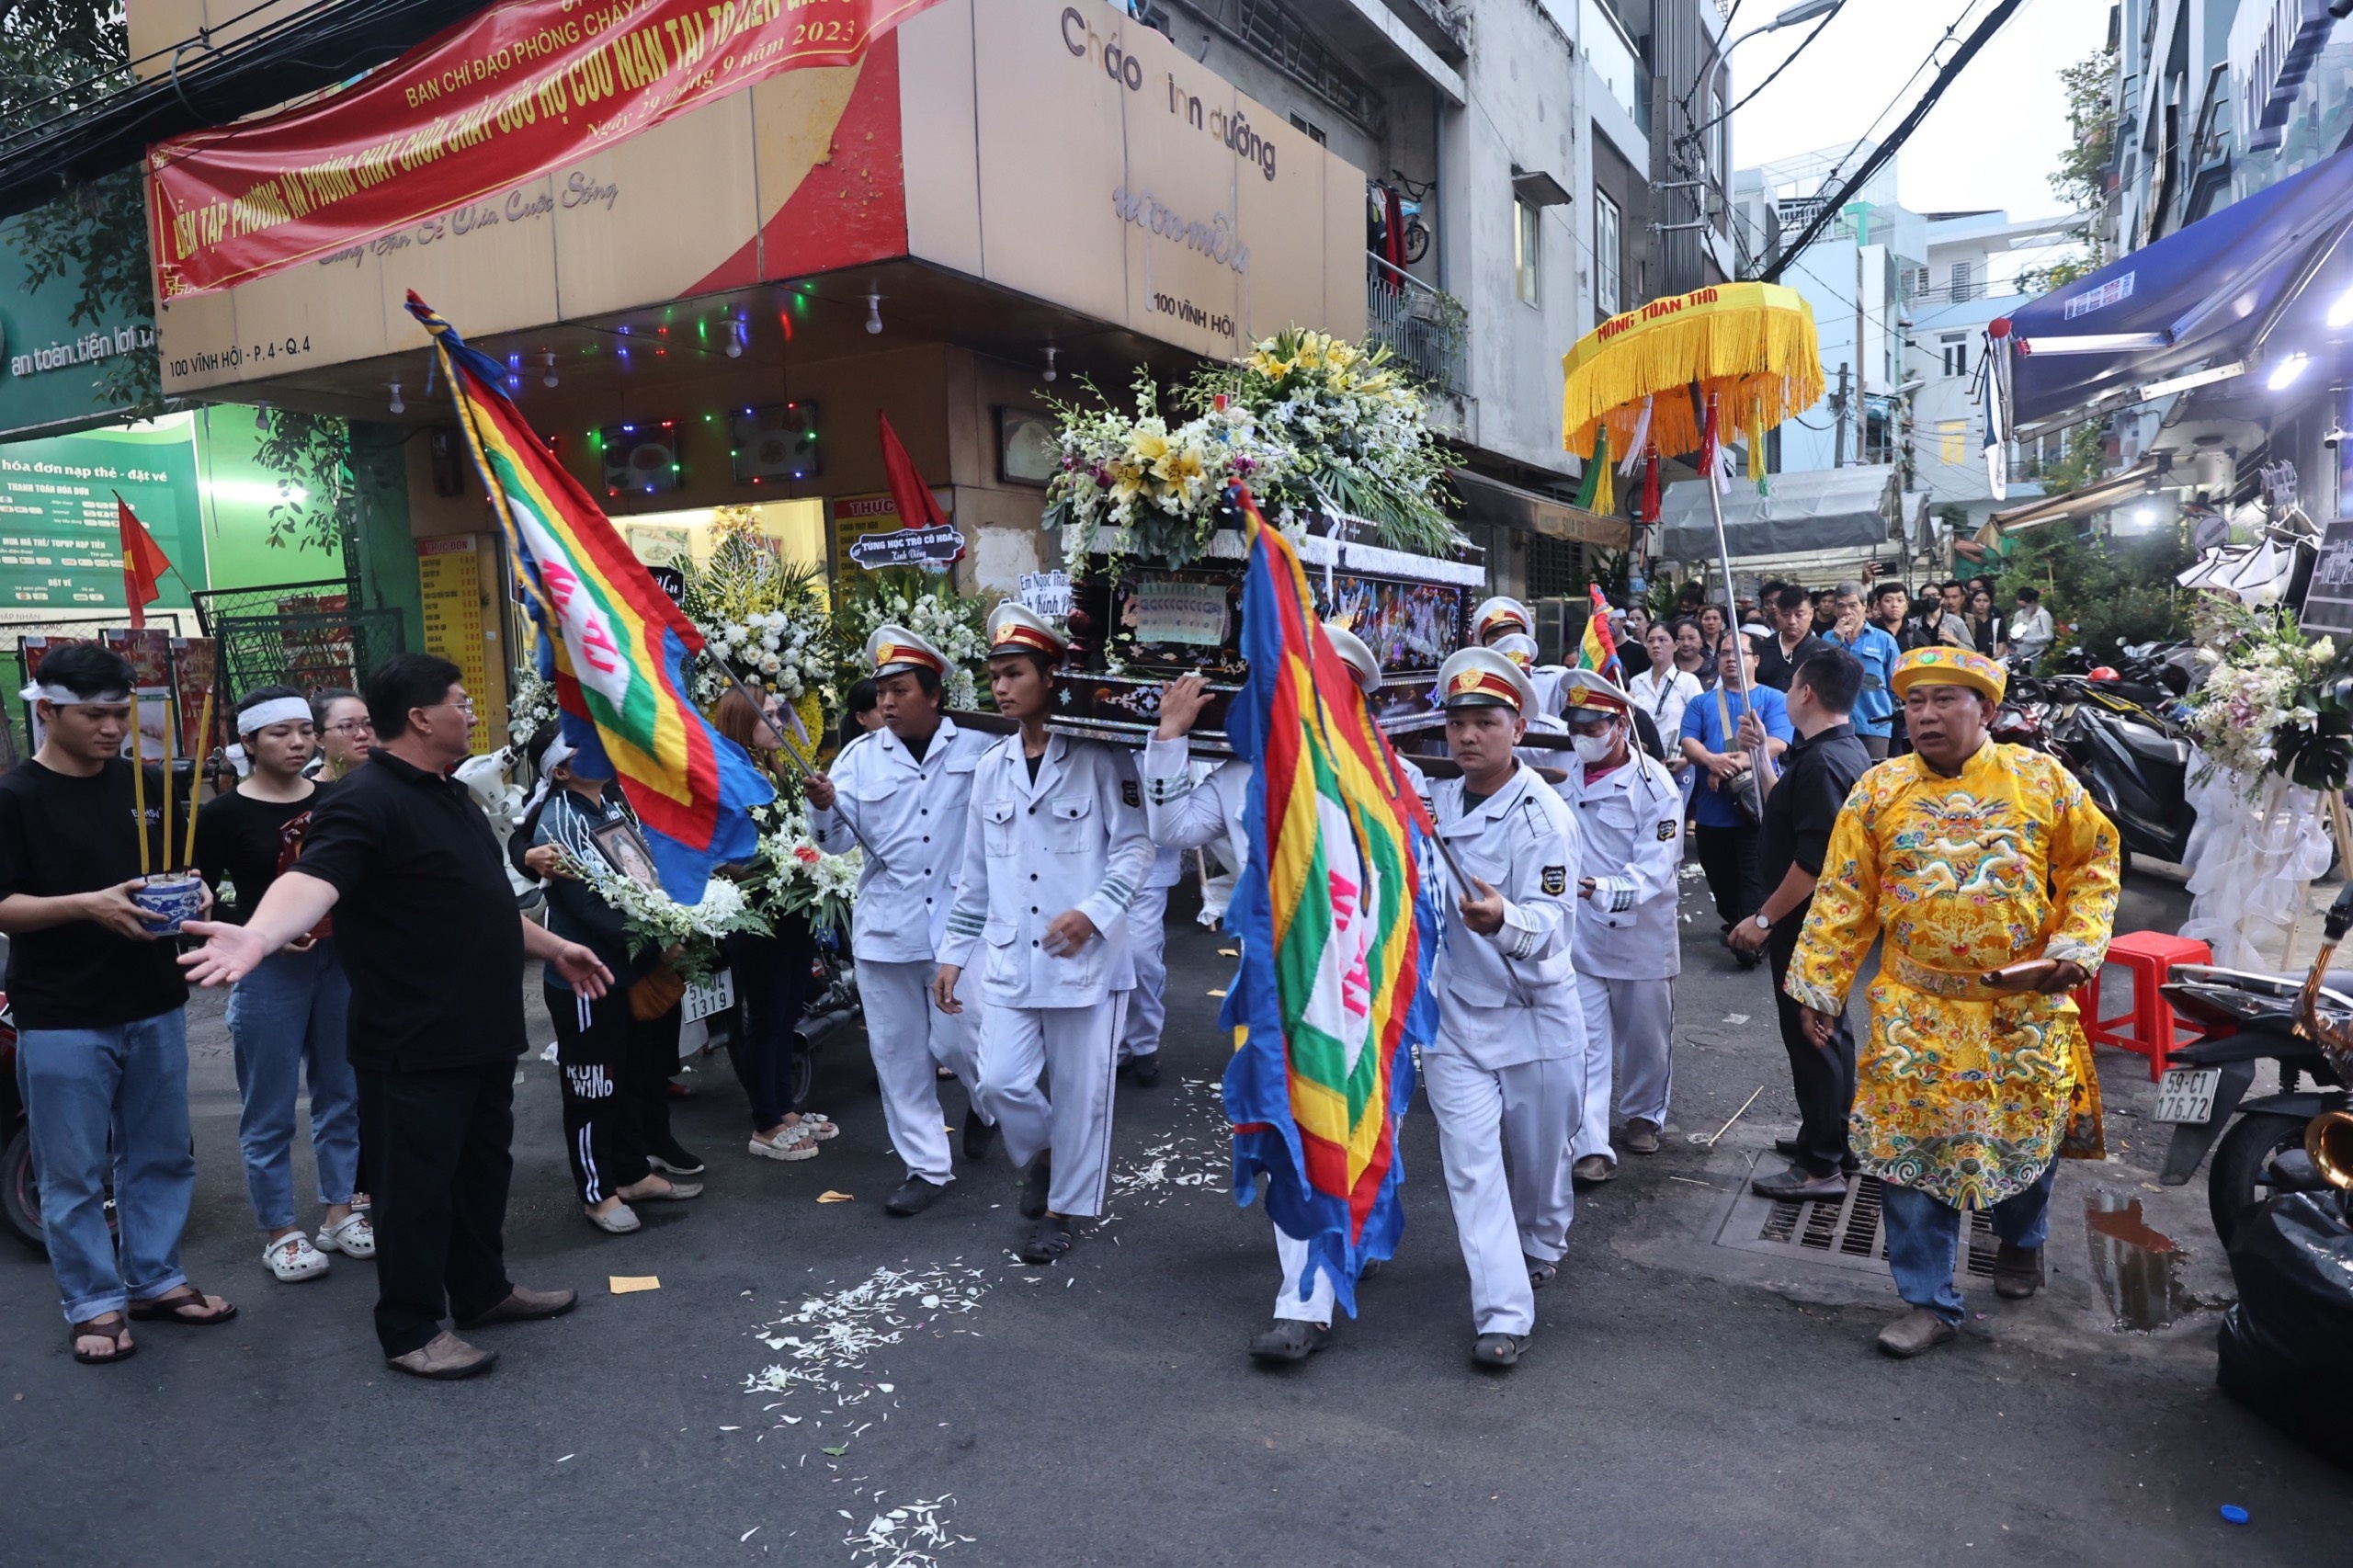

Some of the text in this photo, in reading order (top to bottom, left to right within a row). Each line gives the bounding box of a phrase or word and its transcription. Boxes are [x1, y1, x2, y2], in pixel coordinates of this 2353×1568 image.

[405, 77, 441, 108] BAN
[443, 60, 472, 92] CHỈ
[473, 49, 511, 79] ĐẠO
[513, 21, 580, 64] PHÒNG
[585, 20, 855, 143] Ngày 29 tháng 9 năm 2023
[200, 197, 227, 254] TẬP
[232, 179, 291, 238] PHƯƠNG
[448, 95, 501, 153] CHÁY
[538, 61, 568, 125] HỘ
[612, 25, 668, 96] NẠN
[665, 11, 705, 75] TẠI
[451, 204, 499, 234] Chia
[506, 189, 554, 222] Cuộc
[562, 171, 619, 210] Sống
[1154, 292, 1176, 315] 100
[1211, 314, 1234, 339] HỘI
[11, 354, 33, 376] an
[170, 360, 188, 378] 100
[190, 353, 218, 372] VĨNH
[222, 346, 243, 369] HỘI
[2, 460, 31, 472] hóa
[34, 461, 63, 475] đơn
[64, 465, 91, 479] nạp
[94, 466, 118, 478] thẻ
[127, 469, 150, 483] đặt
[152, 472, 168, 483] vé
[7, 483, 34, 492] THANH
[35, 483, 55, 494] TOÁN
[850, 499, 894, 516] THỰC
[887, 539, 904, 549] HỌC
[924, 534, 935, 543] CÔ
[936, 533, 953, 542] HOA
[1019, 574, 1032, 591] Em
[1033, 572, 1051, 591] Ngọc
[1035, 593, 1058, 615] Kính
[691, 992, 727, 1018] 1319
[566, 1064, 604, 1098] RUN
[2166, 1072, 2208, 1094] 59-C1
[2157, 1096, 2209, 1119] 176.72
